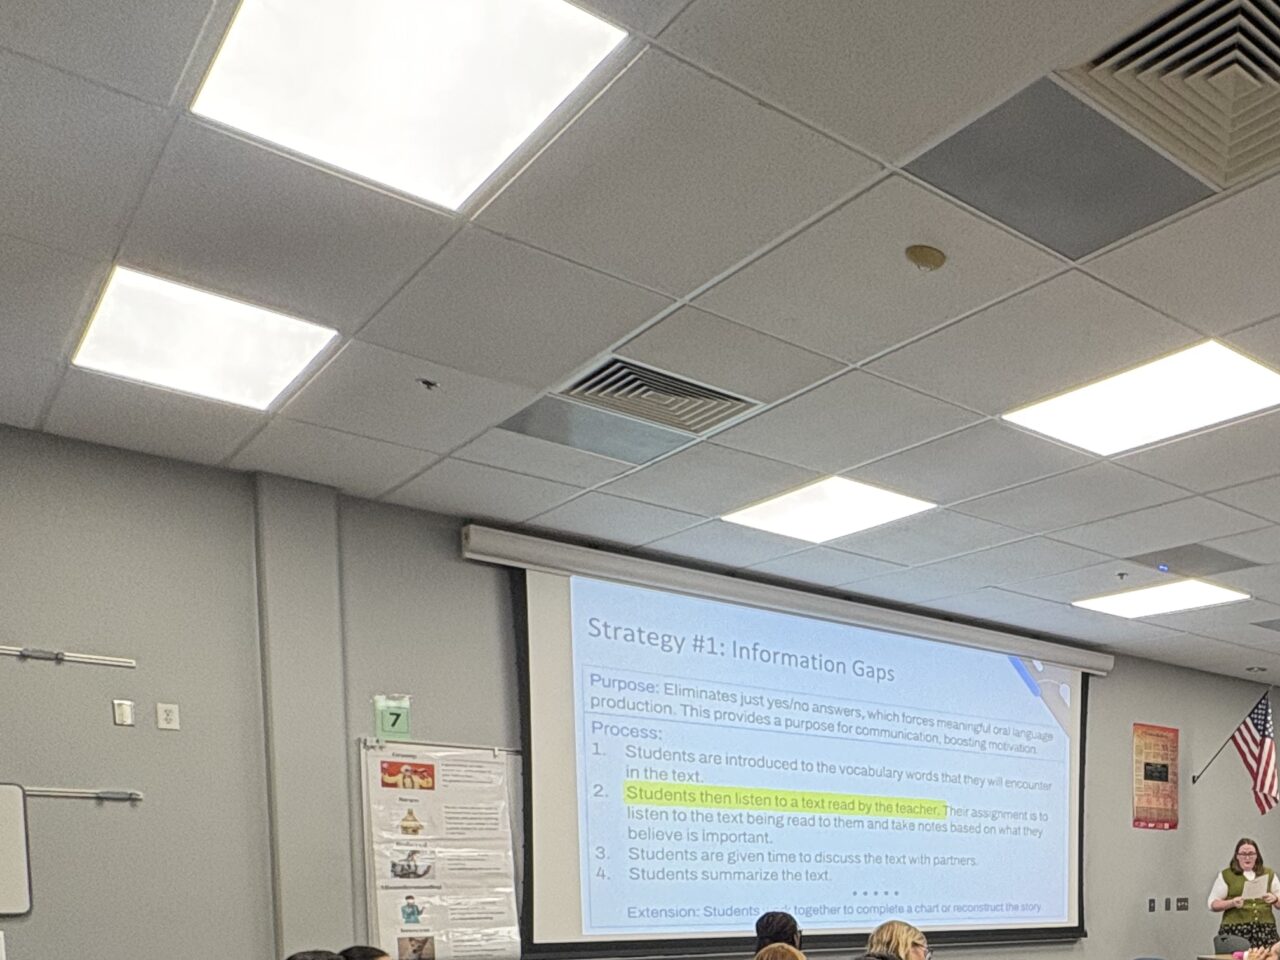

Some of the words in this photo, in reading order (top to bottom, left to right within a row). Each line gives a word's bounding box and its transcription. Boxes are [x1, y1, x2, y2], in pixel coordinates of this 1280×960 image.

[588, 617, 686, 653] Strategy
[692, 634, 725, 656] #1:
[732, 640, 846, 674] Information
[852, 660, 895, 682] Gaps
[590, 673, 659, 694] Purpose:
[664, 683, 737, 703] Eliminates
[740, 694, 764, 707] just
[767, 698, 809, 712] yes/no
[812, 702, 865, 720] answers,
[867, 708, 900, 722] which
[902, 712, 935, 727] forces
[388, 712, 402, 728] 7
[592, 720, 662, 740] Process:
[680, 703, 710, 720] This
[714, 708, 770, 726] provides
[774, 716, 782, 726] a
[785, 718, 834, 732] purpose
[837, 722, 853, 734] for
[855, 725, 942, 745] communication,
[944, 734, 986, 750] boosting
[592, 742, 606, 756] 1.
[625, 744, 696, 764] Students
[699, 752, 722, 766] are
[725, 754, 798, 771] introduced
[801, 758, 814, 772] to
[816, 759, 836, 774] the
[839, 763, 904, 782] vocabulary
[906, 768, 938, 782] words
[942, 772, 961, 784] that
[963, 774, 985, 788] they
[987, 775, 1002, 787] will
[1005, 778, 1052, 791] encounter
[626, 766, 640, 778] in
[644, 766, 668, 780] the
[672, 768, 704, 784] text.
[593, 786, 608, 798] 2.
[626, 786, 696, 802] Students
[700, 788, 731, 804] then
[735, 792, 772, 806] listen
[774, 794, 787, 808] to
[791, 798, 798, 808] a
[801, 796, 824, 810] text
[828, 798, 855, 812] read
[858, 800, 873, 814] by
[875, 802, 893, 814] the
[896, 802, 940, 816] teacher.
[944, 804, 968, 818] Their
[971, 808, 1027, 821] assignment
[1030, 811, 1037, 821] is
[1039, 812, 1048, 822] to
[627, 806, 669, 821] listen
[672, 808, 687, 822] to
[690, 809, 714, 823] the
[717, 810, 743, 824] text
[746, 812, 784, 828] being
[787, 814, 815, 826] read
[818, 816, 830, 828] to
[834, 818, 864, 830] them
[867, 818, 888, 830] and
[891, 820, 916, 832] take
[918, 822, 948, 832] notes
[950, 824, 982, 834] based
[984, 826, 996, 835] on
[998, 826, 1021, 836] what
[1023, 826, 1044, 838] they
[628, 826, 682, 841] believe
[686, 828, 699, 842] is
[702, 829, 773, 845] important.
[595, 846, 610, 860] 3.
[628, 847, 698, 861] Students
[701, 851, 724, 862] are
[727, 850, 764, 864] given
[768, 850, 796, 862] time
[799, 852, 812, 863] to
[814, 852, 862, 864] discuss
[864, 852, 882, 864] the
[884, 853, 906, 864] text
[909, 854, 931, 865] with
[933, 855, 978, 866] partners.
[596, 867, 611, 880] 4.
[629, 867, 698, 880] Students
[701, 869, 778, 881] summarize
[782, 870, 801, 881] the
[805, 870, 832, 881] text.
[627, 906, 700, 918] Extension:
[703, 905, 760, 917] Students
[794, 905, 840, 917] together
[843, 904, 854, 914] to
[856, 904, 905, 916] complete
[907, 906, 912, 914] a
[915, 903, 939, 914] chart
[941, 905, 950, 913] or
[953, 902, 1004, 913] reconstruct
[1006, 902, 1019, 912] the
